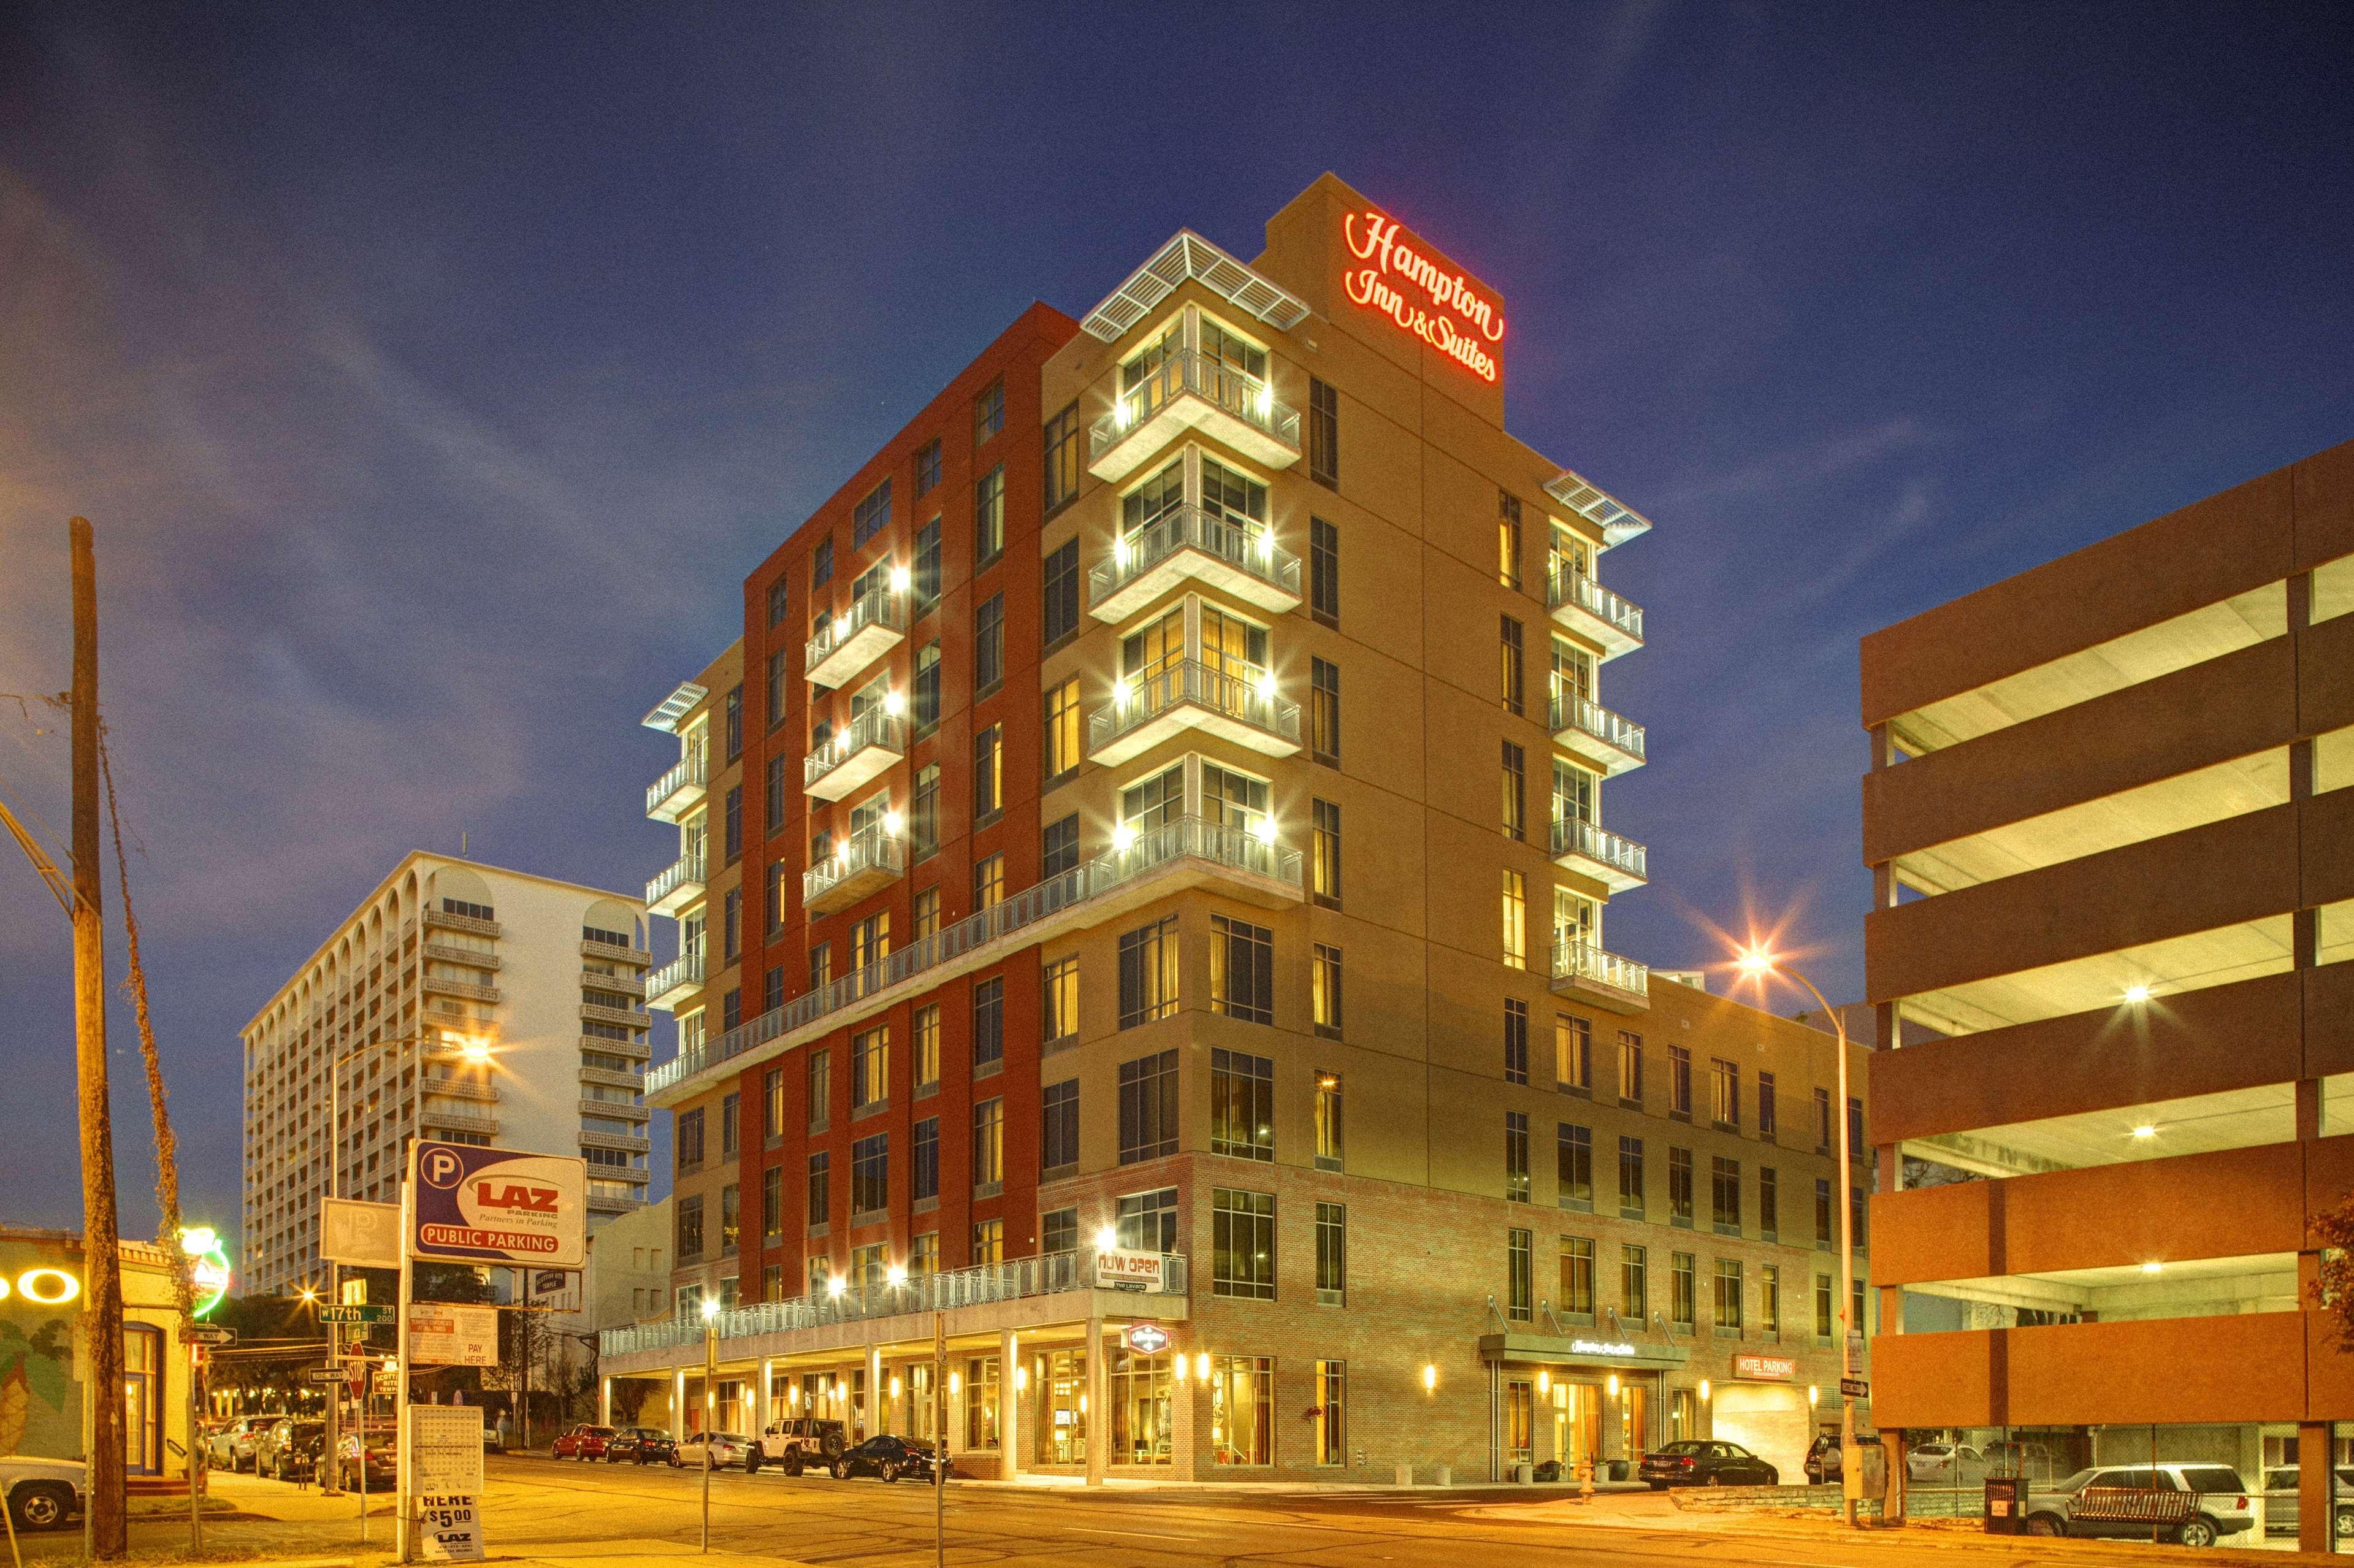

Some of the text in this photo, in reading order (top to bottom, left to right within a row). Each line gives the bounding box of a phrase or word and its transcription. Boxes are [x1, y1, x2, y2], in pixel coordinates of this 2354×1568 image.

[1346, 213, 1504, 341] Hampton
[1345, 270, 1496, 381] Inn & Suites
[434, 1155, 455, 1182] P
[478, 1182, 559, 1212] LAZ
[480, 1214, 514, 1224] Partners
[527, 1218, 557, 1229] Parking
[506, 1209, 558, 1219] PARKING
[427, 1228, 555, 1251] PUBLIC PARKING
[331, 1307, 361, 1321] 17th
[468, 1344, 483, 1353] PAY
[464, 1355, 486, 1365] HERE
[1740, 1358, 1792, 1374] HOTEL PARKING
[350, 1360, 365, 1382] STOP
[438, 1533, 472, 1543] LAZ
